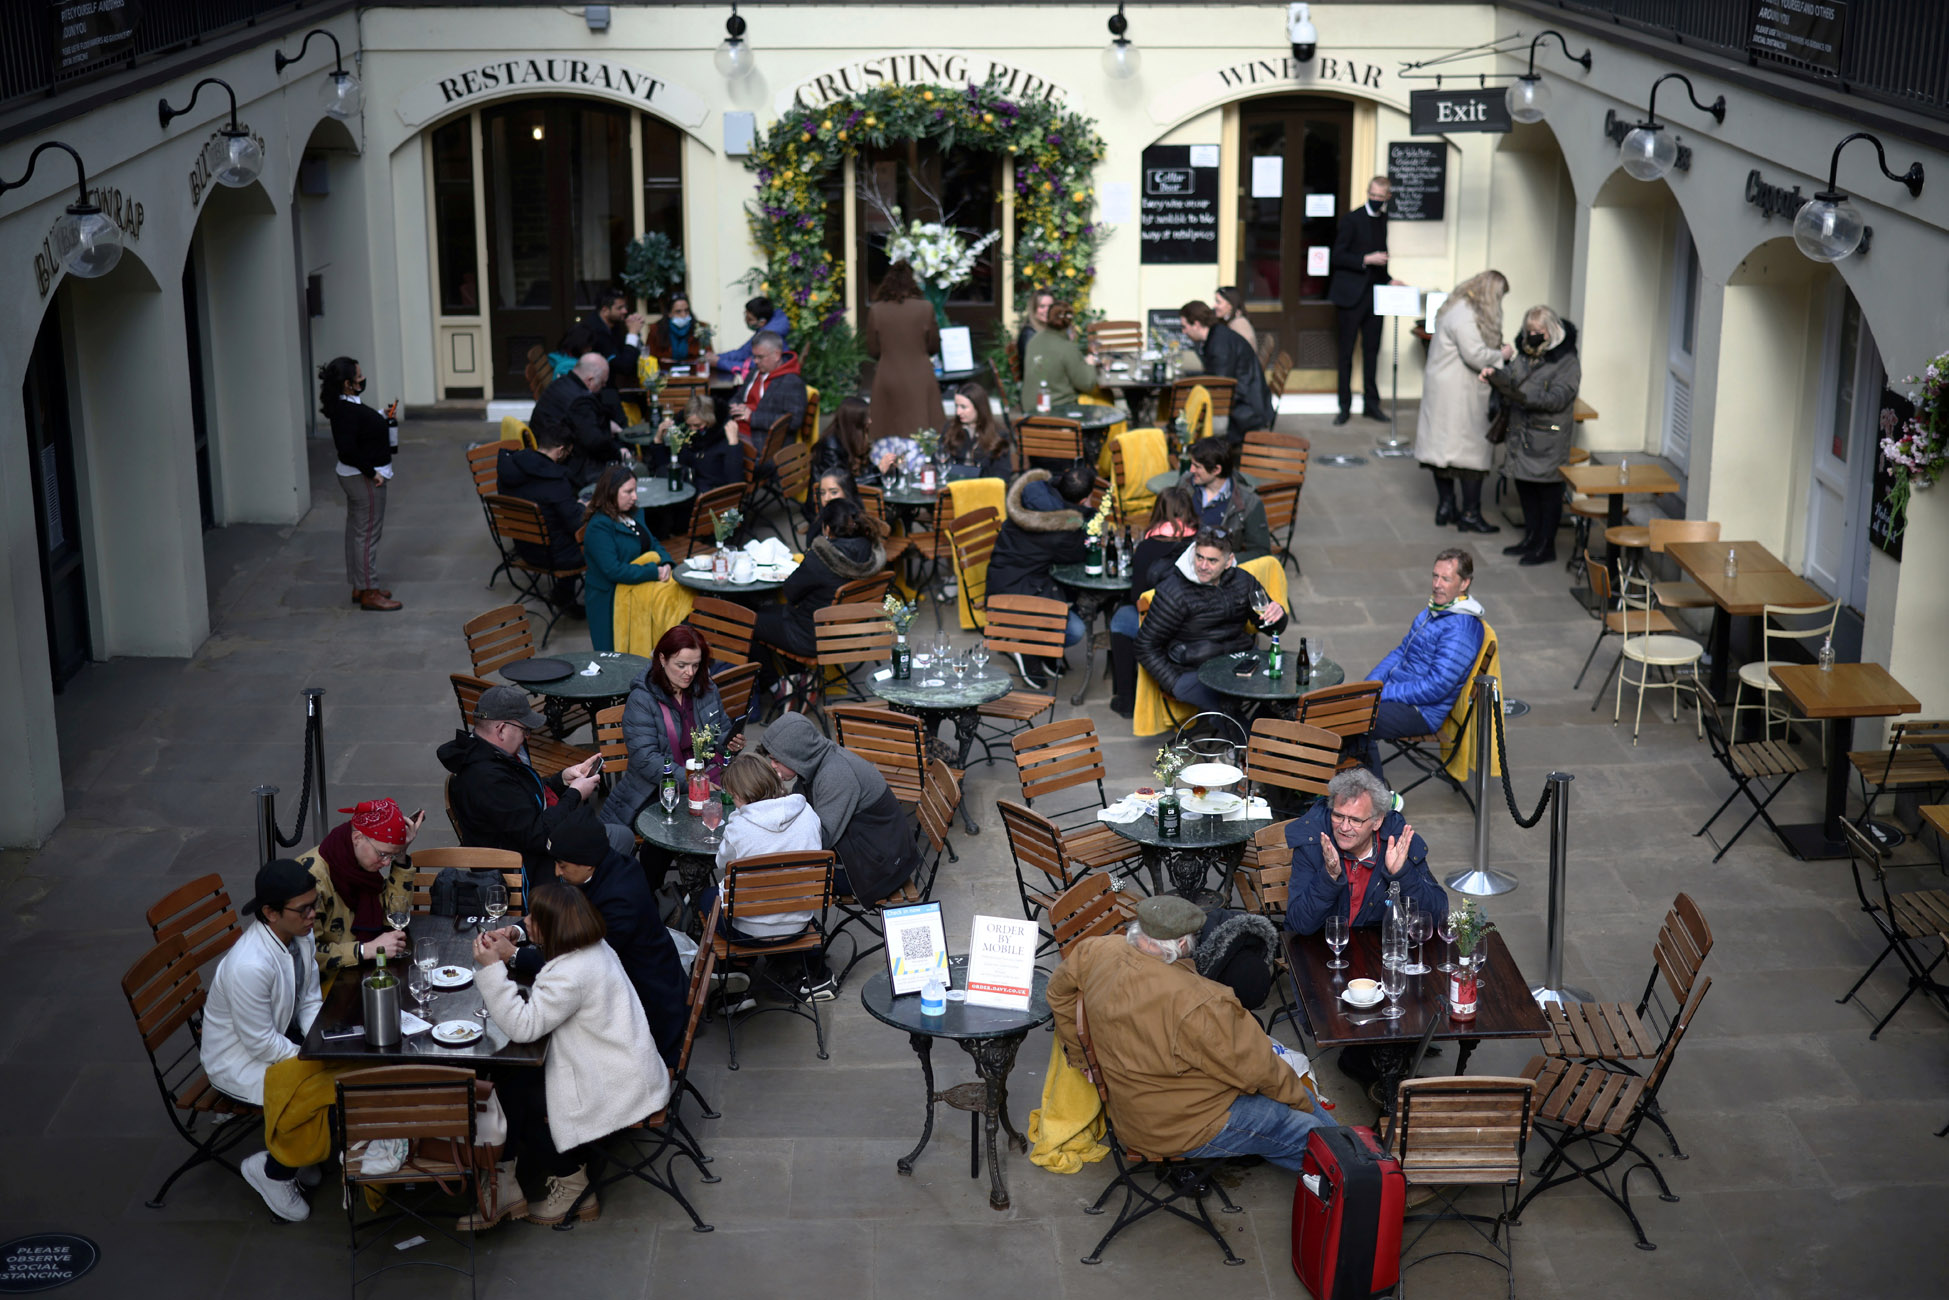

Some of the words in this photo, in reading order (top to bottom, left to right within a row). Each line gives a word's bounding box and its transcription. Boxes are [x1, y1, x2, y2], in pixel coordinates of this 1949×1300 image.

[437, 59, 664, 102] RESTAURANT
[795, 53, 968, 107] CRUSTING
[1219, 57, 1299, 87] WINE
[1320, 57, 1382, 88] BAR
[1436, 99, 1487, 122] Exit
[986, 924, 1024, 936] ORDER
[998, 934, 1011, 944] BY
[982, 943, 1024, 956] MOBILE
[6, 1255, 72, 1263] OBSERVE
